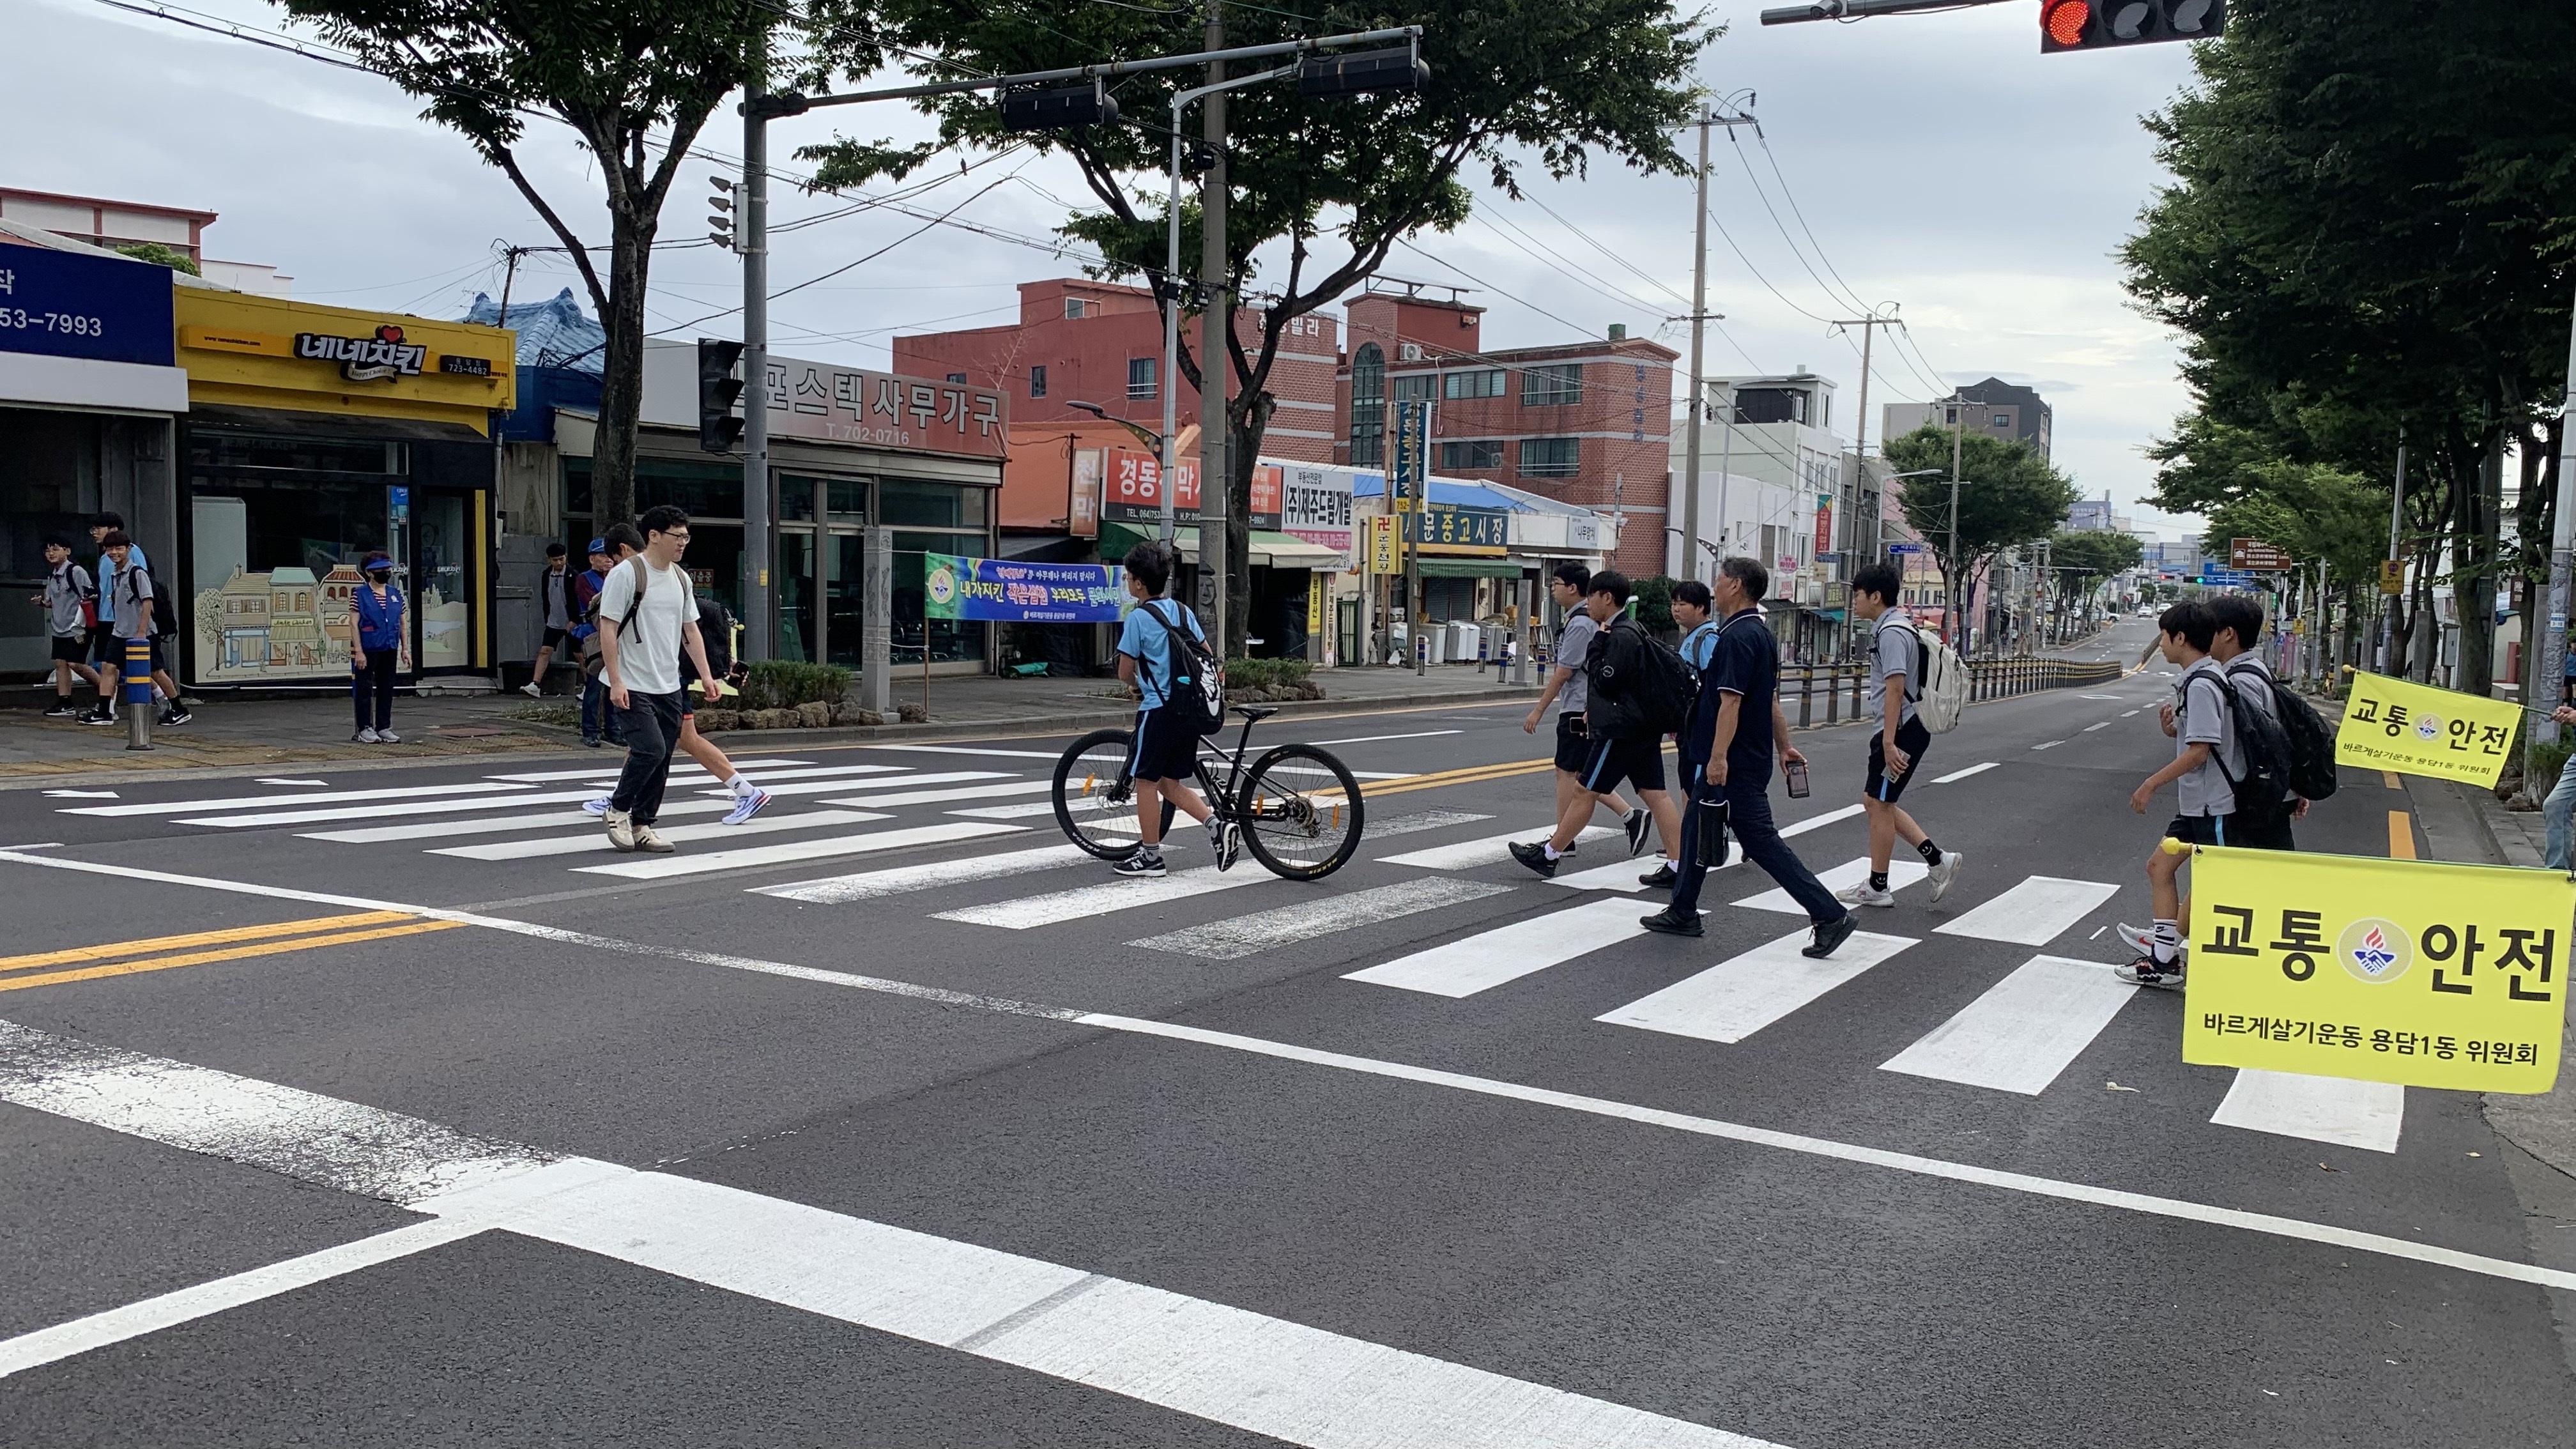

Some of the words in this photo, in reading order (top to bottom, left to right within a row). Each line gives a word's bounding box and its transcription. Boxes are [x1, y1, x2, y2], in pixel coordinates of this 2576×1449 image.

[0, 307, 102, 337] 53-7993
[302, 335, 424, 375] 네네치킨
[448, 364, 487, 375] 723-4482
[872, 379, 999, 436] 사무가구
[826, 423, 838, 438] T.
[845, 425, 909, 445] 702-0716
[1076, 459, 1096, 522] 천막
[1119, 459, 1201, 500] 경동막
[1139, 509, 1161, 519] 064)753
[1285, 484, 1352, 525] (주)제주드림개발
[1404, 513, 1503, 544] 문중고시장
[690, 571, 711, 583] 외출중
[2350, 698, 2409, 737] 교통
[2448, 719, 2508, 755] 안전
[2343, 742, 2413, 763] 바르게살기운동
[2416, 757, 2454, 769] 용담1동
[2458, 764, 2490, 776] 위원회
[1131, 860, 1144, 870] N
[2202, 904, 2331, 982] 교통
[2421, 924, 2556, 1002] 안전
[2204, 1013, 2363, 1048] 바르게살기운동
[2369, 1029, 2458, 1061] 용담1동
[2465, 1041, 2538, 1066] 위원회
